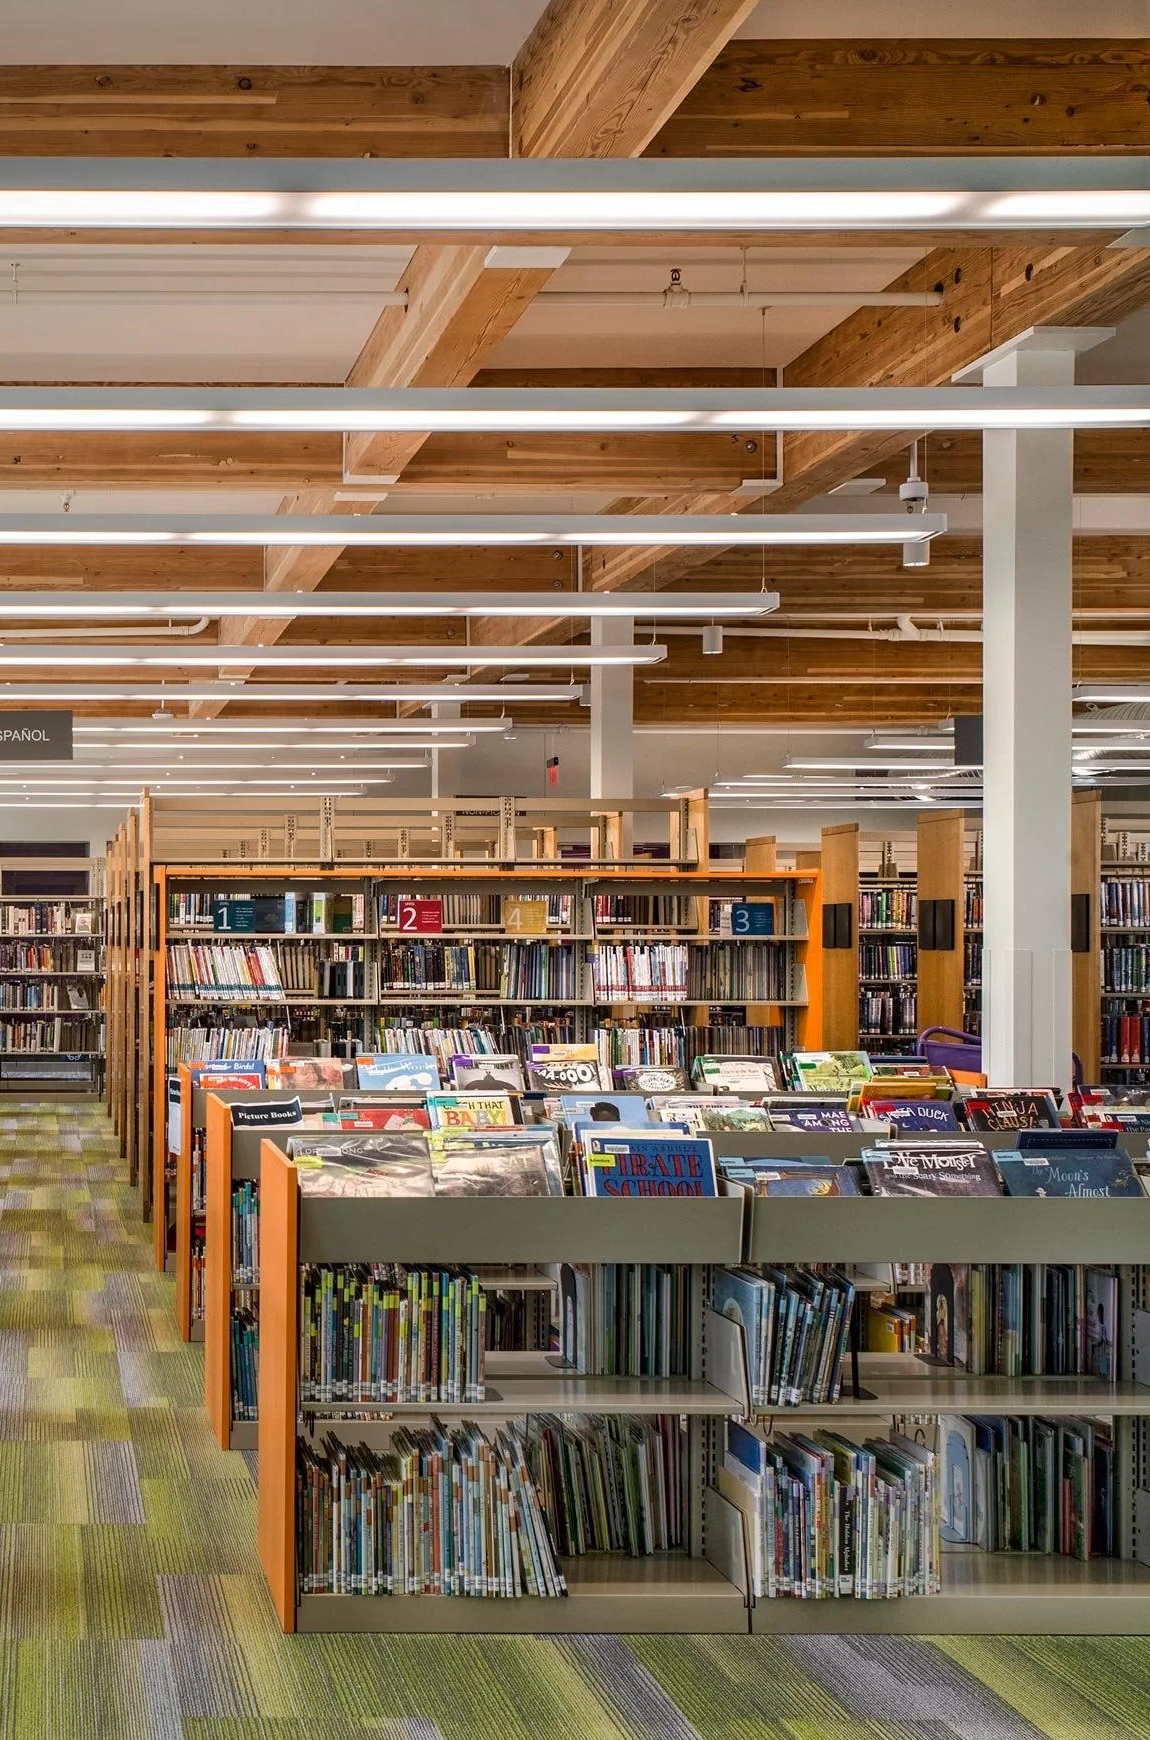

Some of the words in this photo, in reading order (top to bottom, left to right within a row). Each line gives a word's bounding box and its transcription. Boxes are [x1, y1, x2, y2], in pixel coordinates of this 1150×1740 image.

[218, 907, 232, 930] 1
[402, 907, 418, 930] 2
[507, 908, 523, 930] 4
[735, 910, 750, 932] 3
[233, 1063, 255, 1071] Birds!
[479, 1101, 504, 1109] THAT
[238, 1112, 269, 1120] Picture
[271, 1110, 297, 1119] Books
[444, 1110, 506, 1126] BABY!
[821, 1111, 847, 1119] MAE
[917, 1106, 949, 1122] DUCK
[602, 1153, 704, 1178] IRATE
[919, 1154, 976, 1170] Monster
[1045, 1166, 1089, 1183] Moon's
[1065, 1183, 1111, 1197] Almost
[843, 1547, 851, 1571] Alphabet
